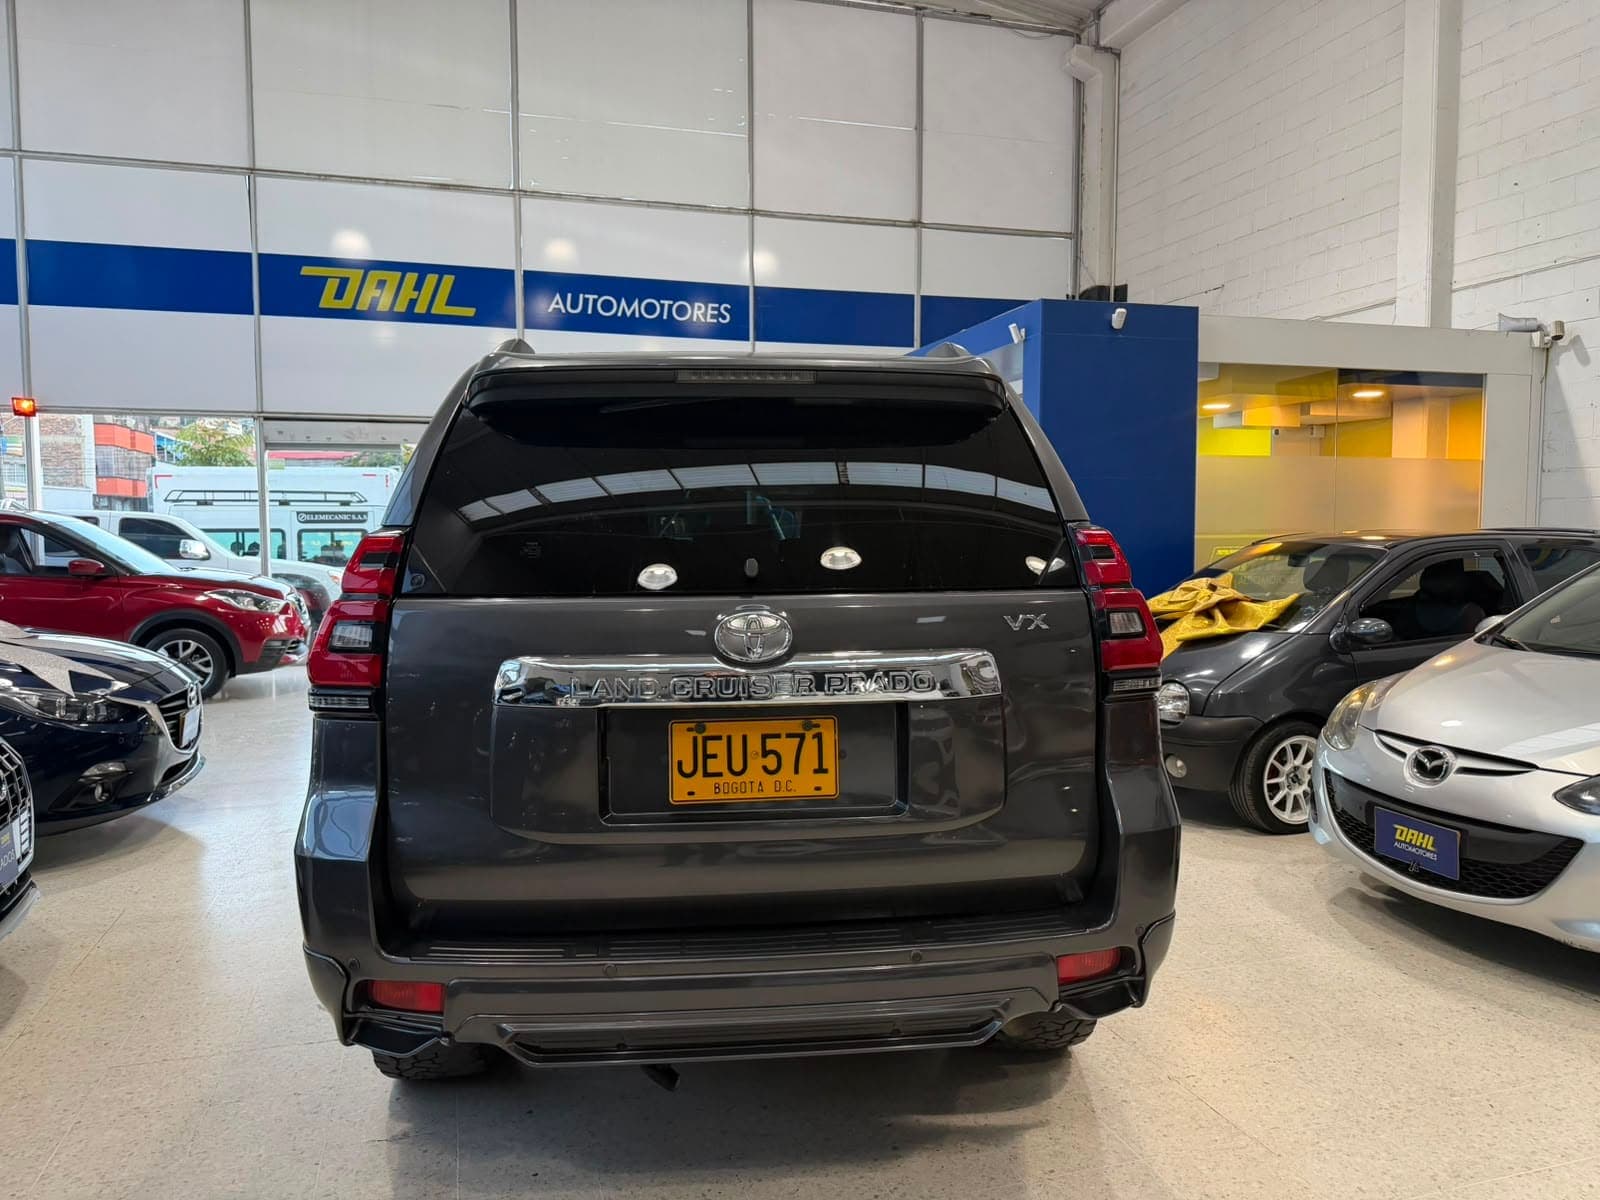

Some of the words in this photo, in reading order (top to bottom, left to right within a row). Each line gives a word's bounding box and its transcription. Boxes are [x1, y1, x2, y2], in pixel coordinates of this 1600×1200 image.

[300, 266, 477, 317] DAHL
[548, 292, 732, 324] AUTOMOTORES
[1003, 613, 1049, 631] VX
[570, 677, 660, 699] LAND
[669, 673, 817, 699] CRUISER
[825, 670, 936, 696] PRADO
[677, 735, 748, 779] JEU
[761, 732, 829, 776] 571
[713, 780, 764, 795] BOGOTA
[1393, 824, 1437, 851] DAHL
[1393, 842, 1437, 861] AUTOMOTORES
